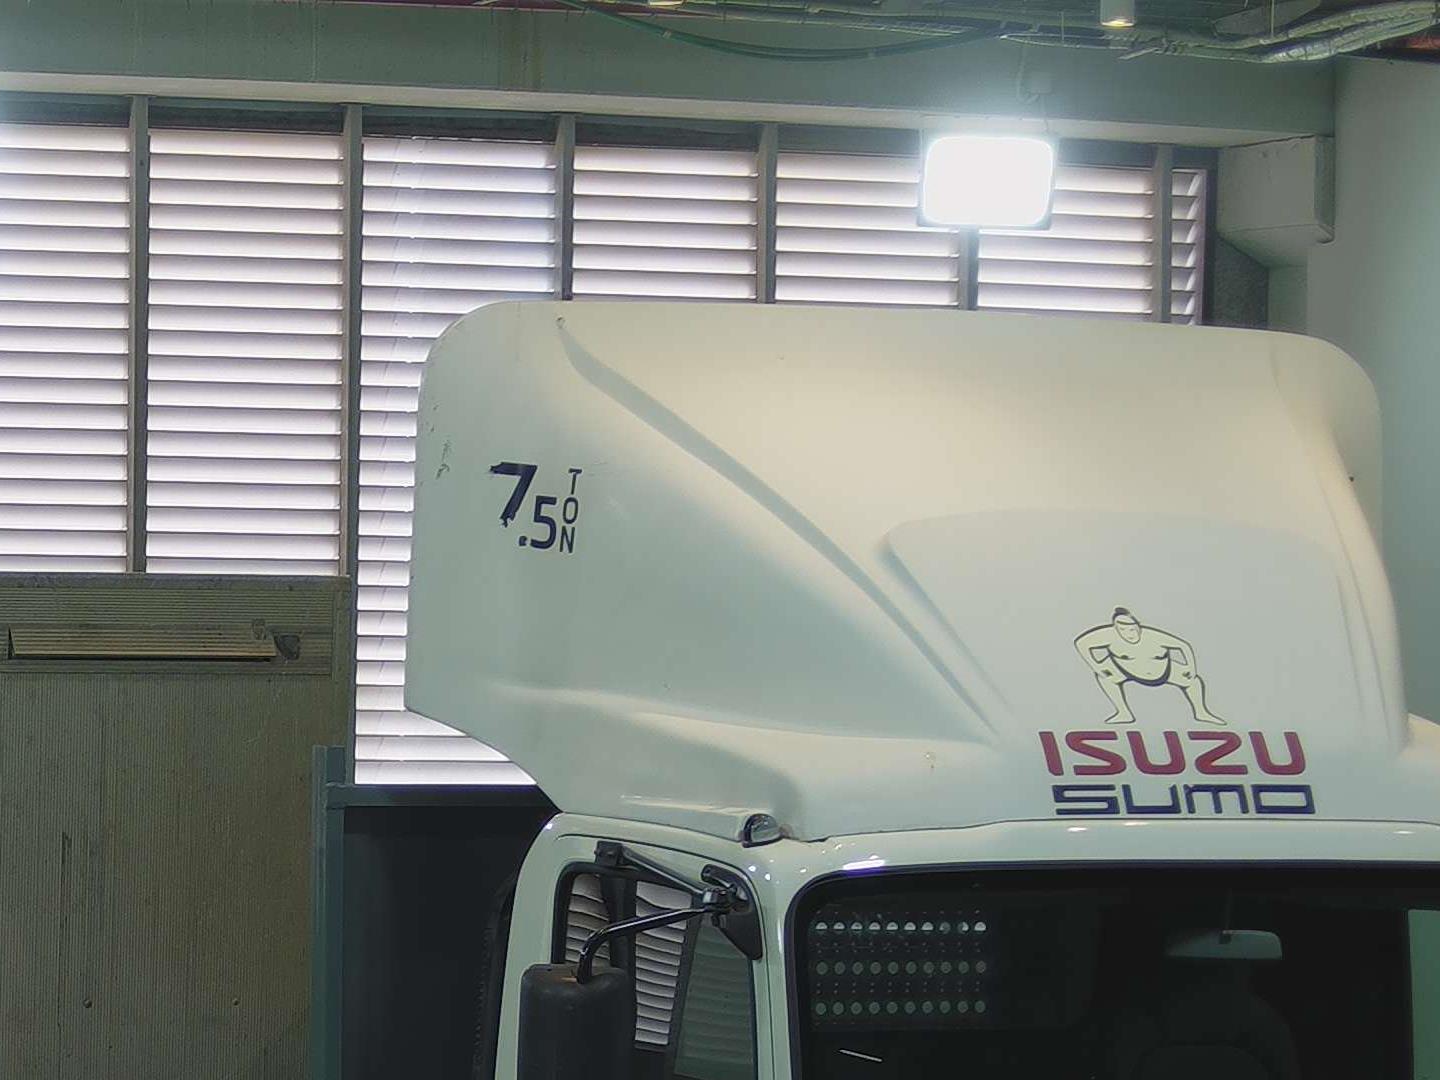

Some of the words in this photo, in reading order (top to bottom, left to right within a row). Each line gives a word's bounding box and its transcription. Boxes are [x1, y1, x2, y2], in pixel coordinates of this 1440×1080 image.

[560, 467, 582, 553] TON
[1038, 730, 1307, 777] ISUZU
[1051, 784, 1316, 815] SUMO
